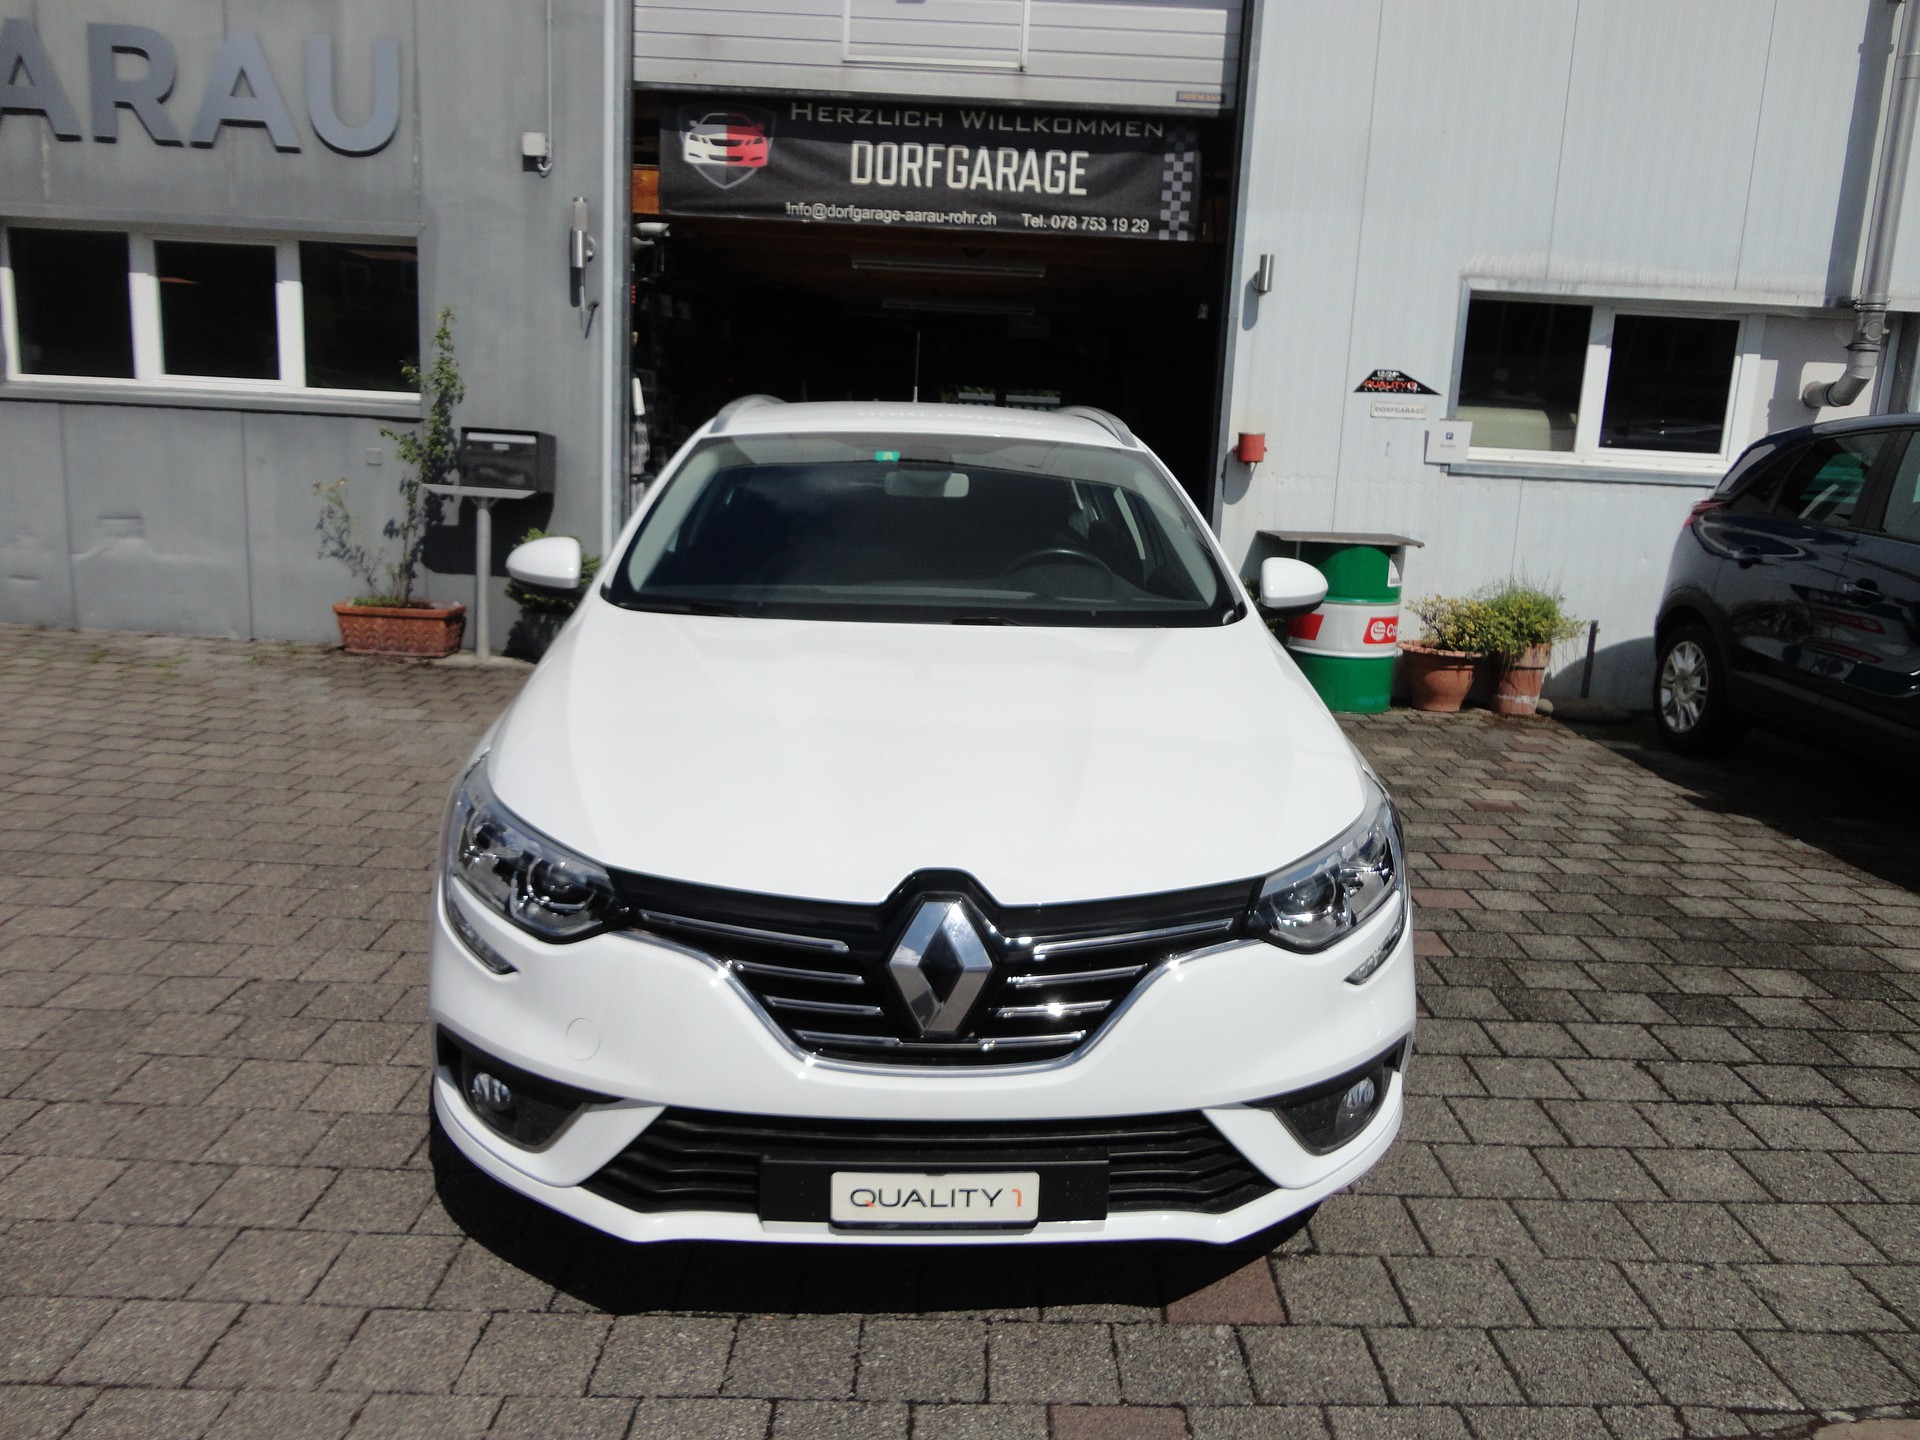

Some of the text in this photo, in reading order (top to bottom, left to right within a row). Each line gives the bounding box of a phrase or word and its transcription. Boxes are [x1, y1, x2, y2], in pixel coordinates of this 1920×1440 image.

[0, 18, 400, 157] ARAU
[850, 140, 1089, 195] DORFGARAGE
[1021, 213, 1047, 228] Tel.
[1050, 214, 1077, 230] 078
[1081, 216, 1107, 231] 753
[1111, 218, 1128, 232] 19
[1131, 219, 1150, 234] 29
